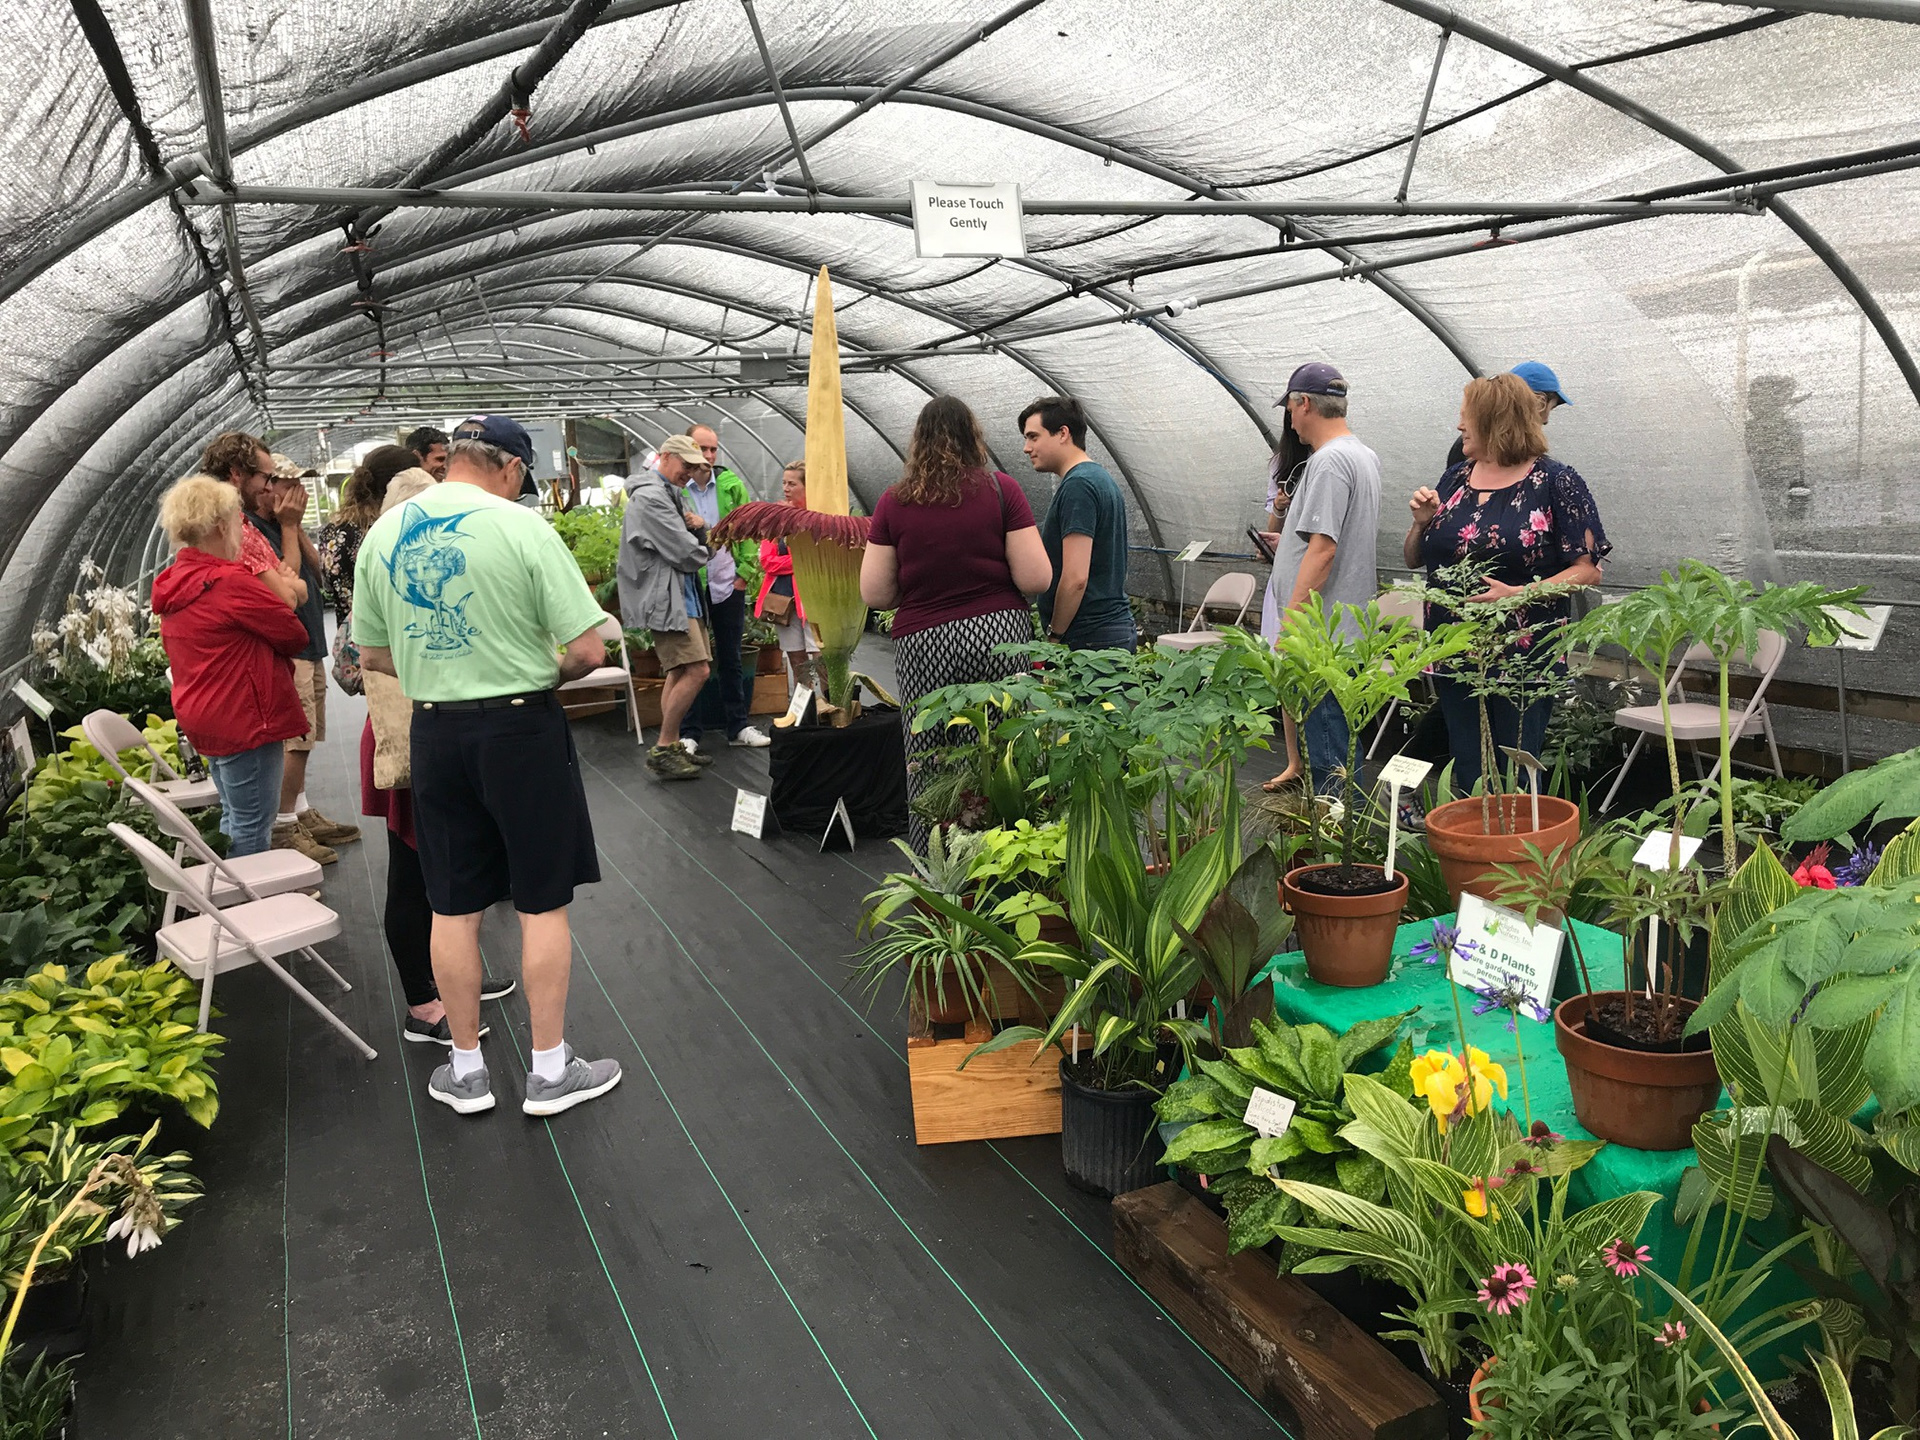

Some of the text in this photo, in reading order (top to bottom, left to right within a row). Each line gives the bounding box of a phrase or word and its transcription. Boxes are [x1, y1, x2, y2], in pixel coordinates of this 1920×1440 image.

[928, 196, 1004, 210] Please Touch
[949, 216, 988, 231] Gently
[1479, 943, 1486, 956] &
[1490, 948, 1499, 960] D
[1500, 953, 1536, 977] Plants
